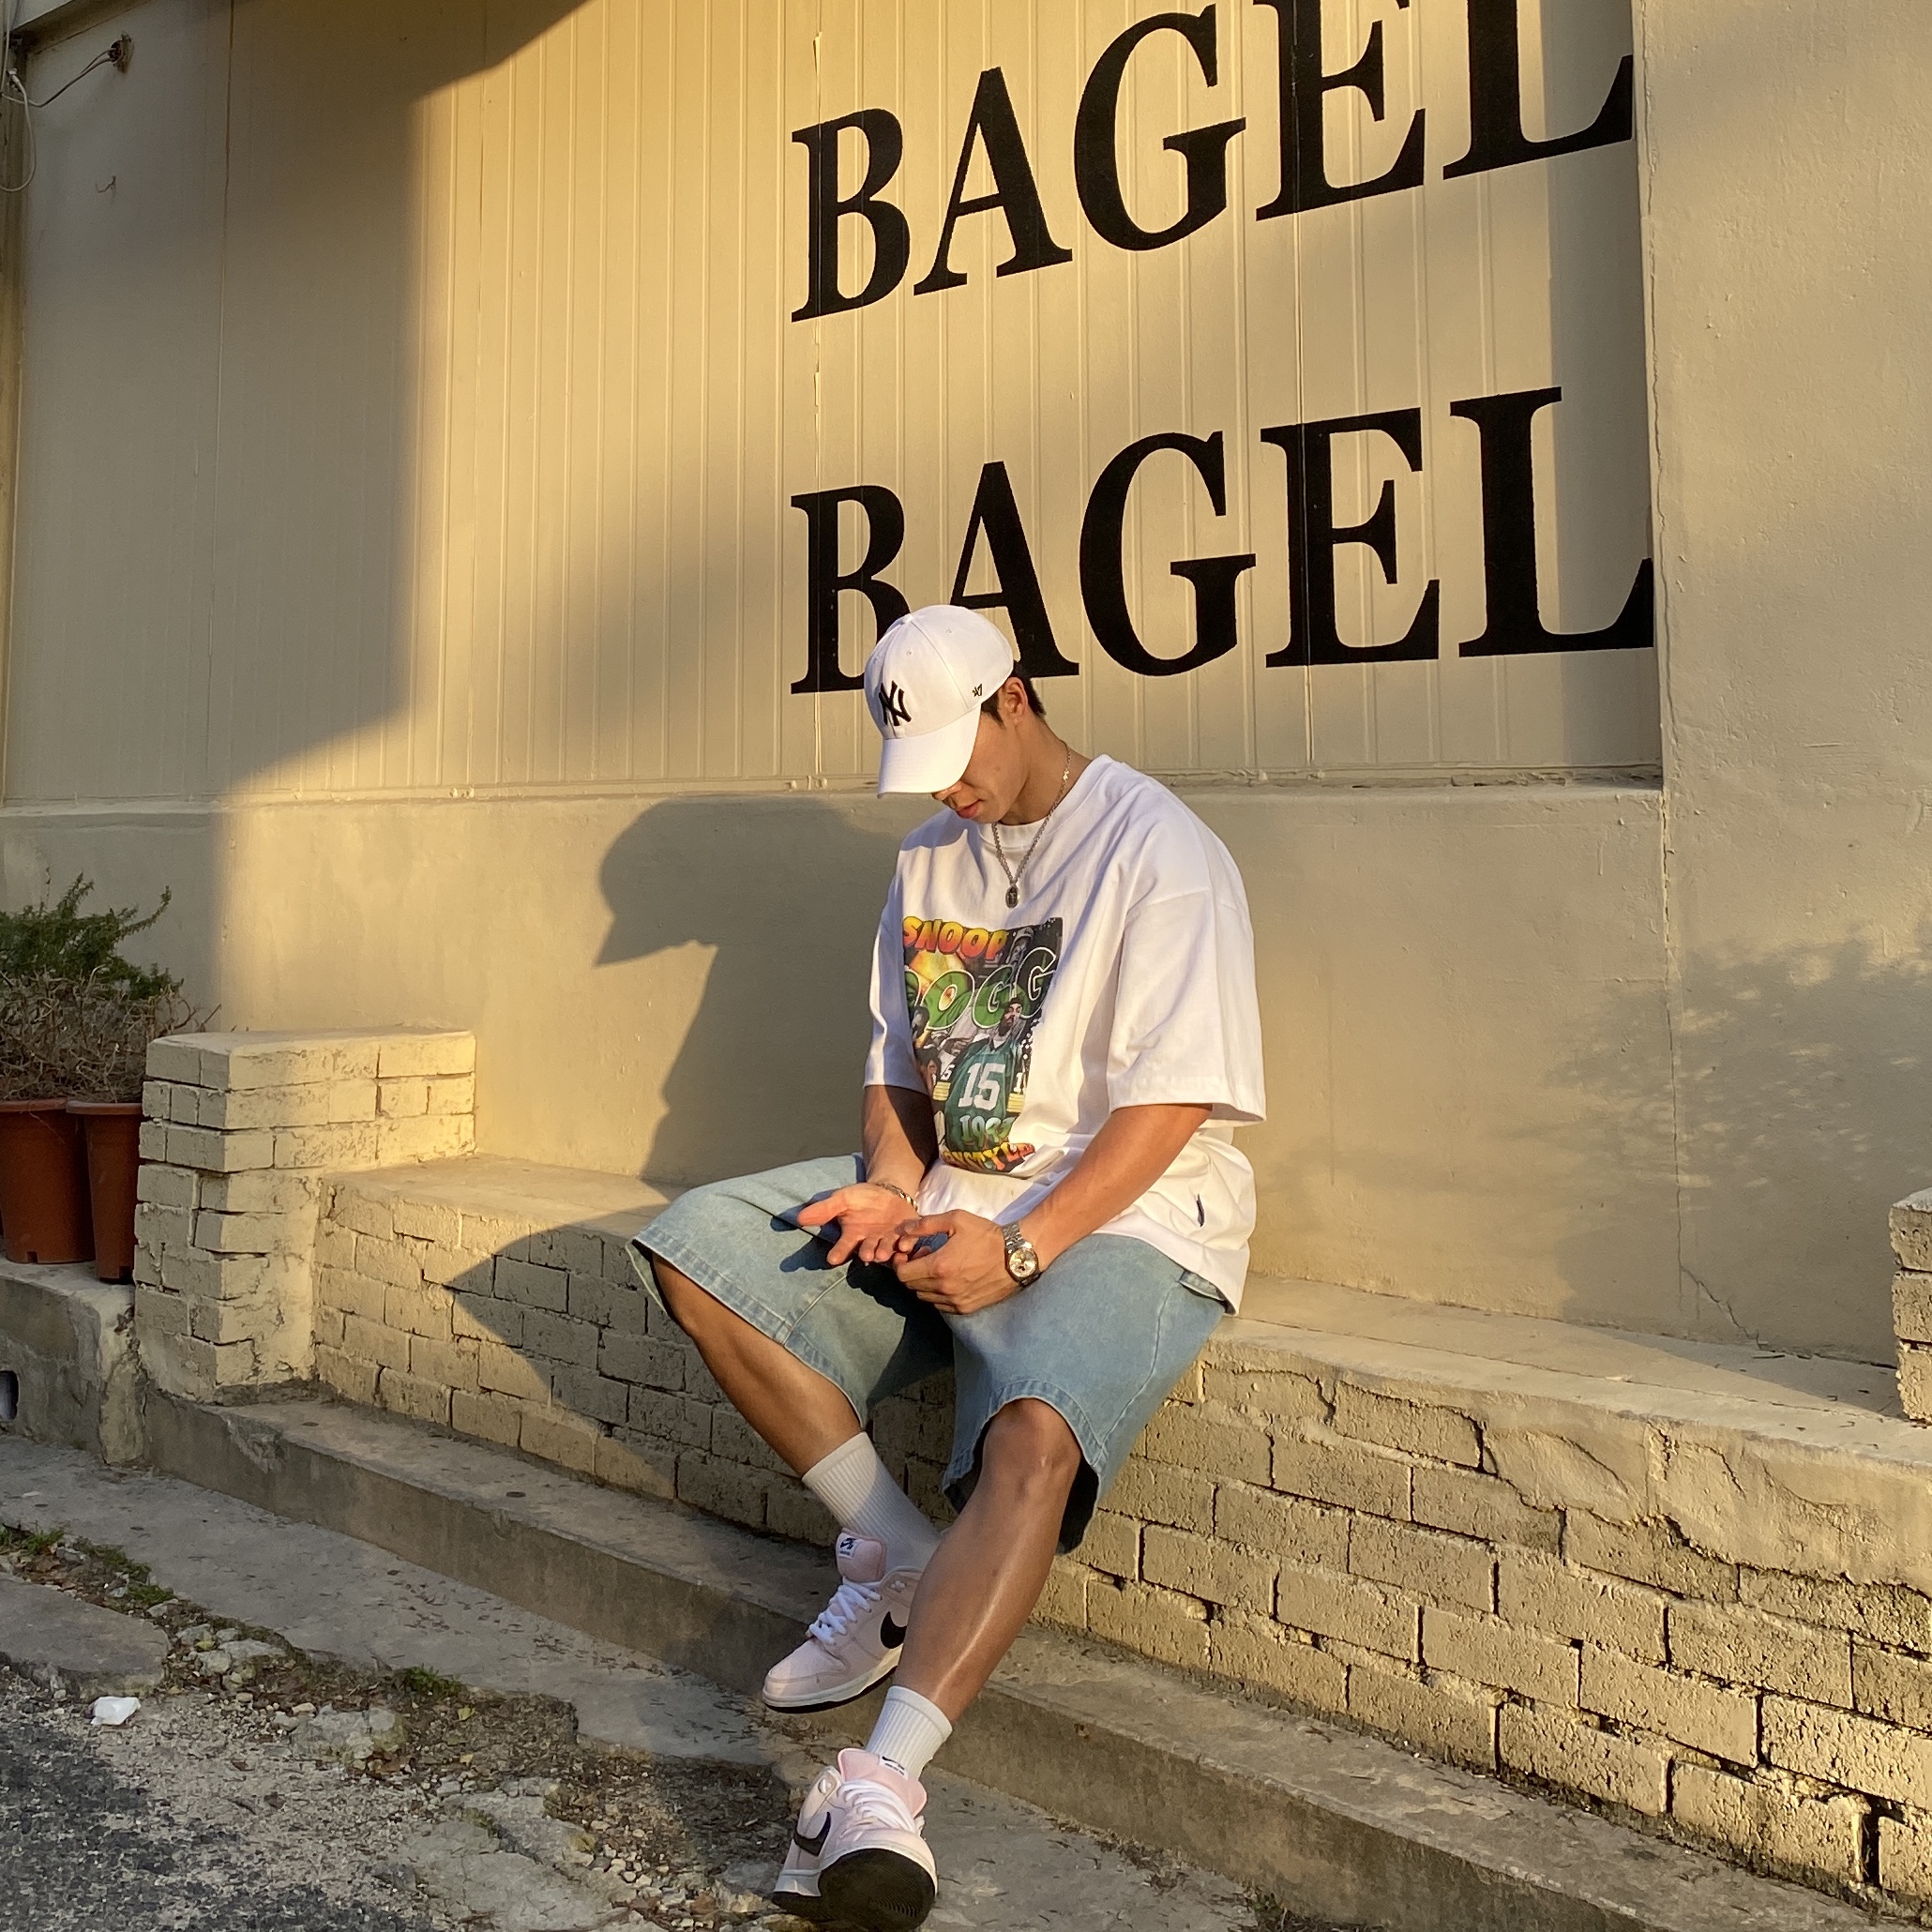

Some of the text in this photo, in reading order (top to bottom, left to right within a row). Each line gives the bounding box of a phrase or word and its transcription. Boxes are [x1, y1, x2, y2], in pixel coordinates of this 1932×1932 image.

[791, 0, 1634, 323] BAGEL
[790, 385, 1654, 694] BAGEL
[878, 680, 913, 727] NY
[902, 915, 1009, 960] SNOOP
[958, 1062, 1006, 1111] 15
